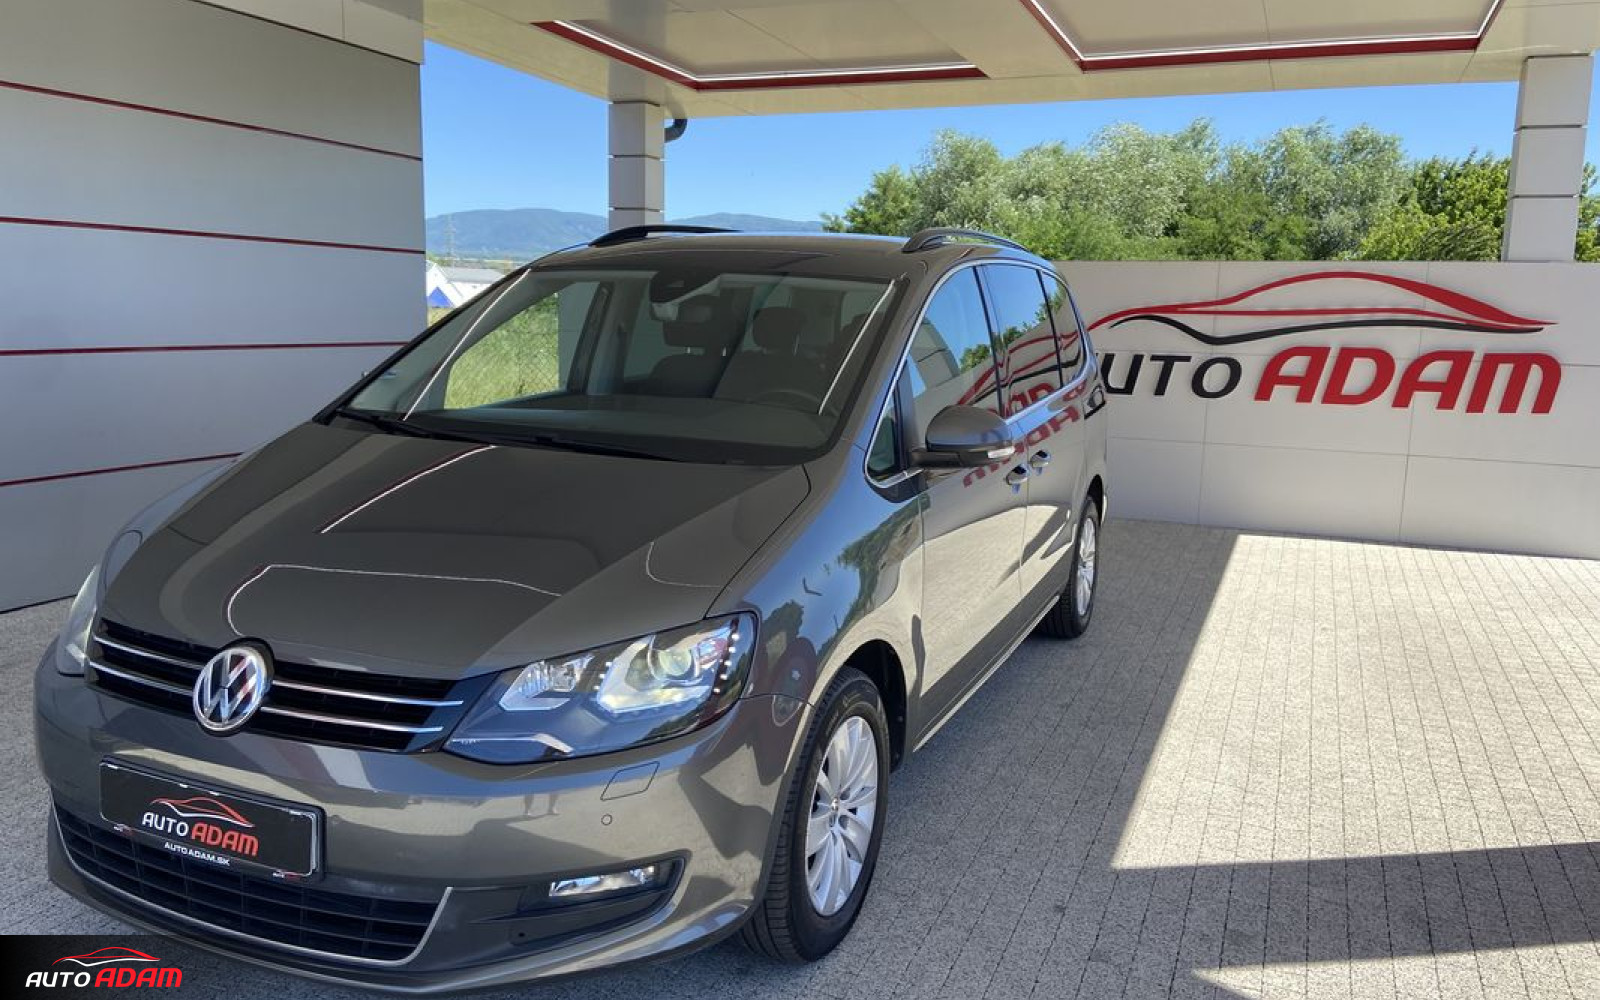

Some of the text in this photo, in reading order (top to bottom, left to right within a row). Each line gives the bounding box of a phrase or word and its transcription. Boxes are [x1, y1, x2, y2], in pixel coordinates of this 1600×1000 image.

[1096, 346, 1562, 414] UTO ADAM
[142, 811, 189, 837] AUTO
[191, 821, 259, 857] ADAM
